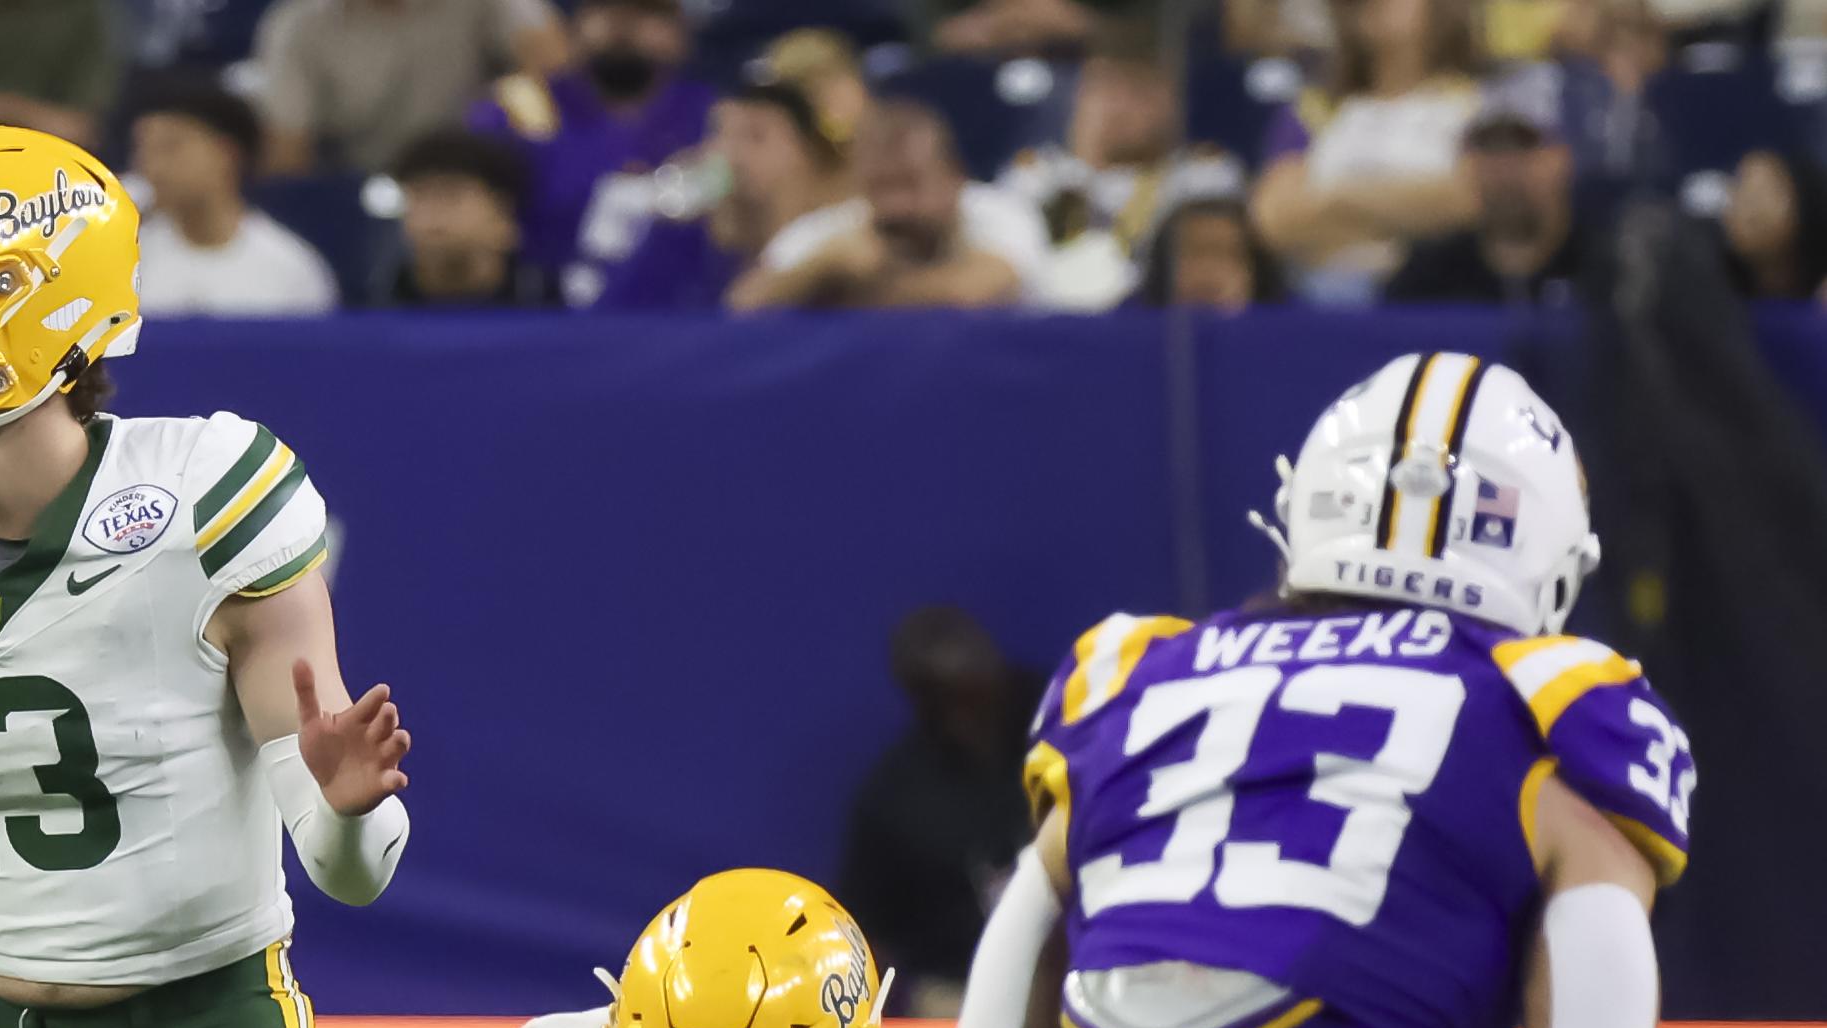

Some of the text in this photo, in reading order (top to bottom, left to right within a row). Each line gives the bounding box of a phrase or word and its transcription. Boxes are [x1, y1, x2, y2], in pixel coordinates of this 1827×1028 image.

[98, 499, 165, 539] TEXAS
[1334, 559, 1484, 608] TIGERS
[1191, 608, 1453, 673] WEEKS
[1079, 664, 1466, 927] 33
